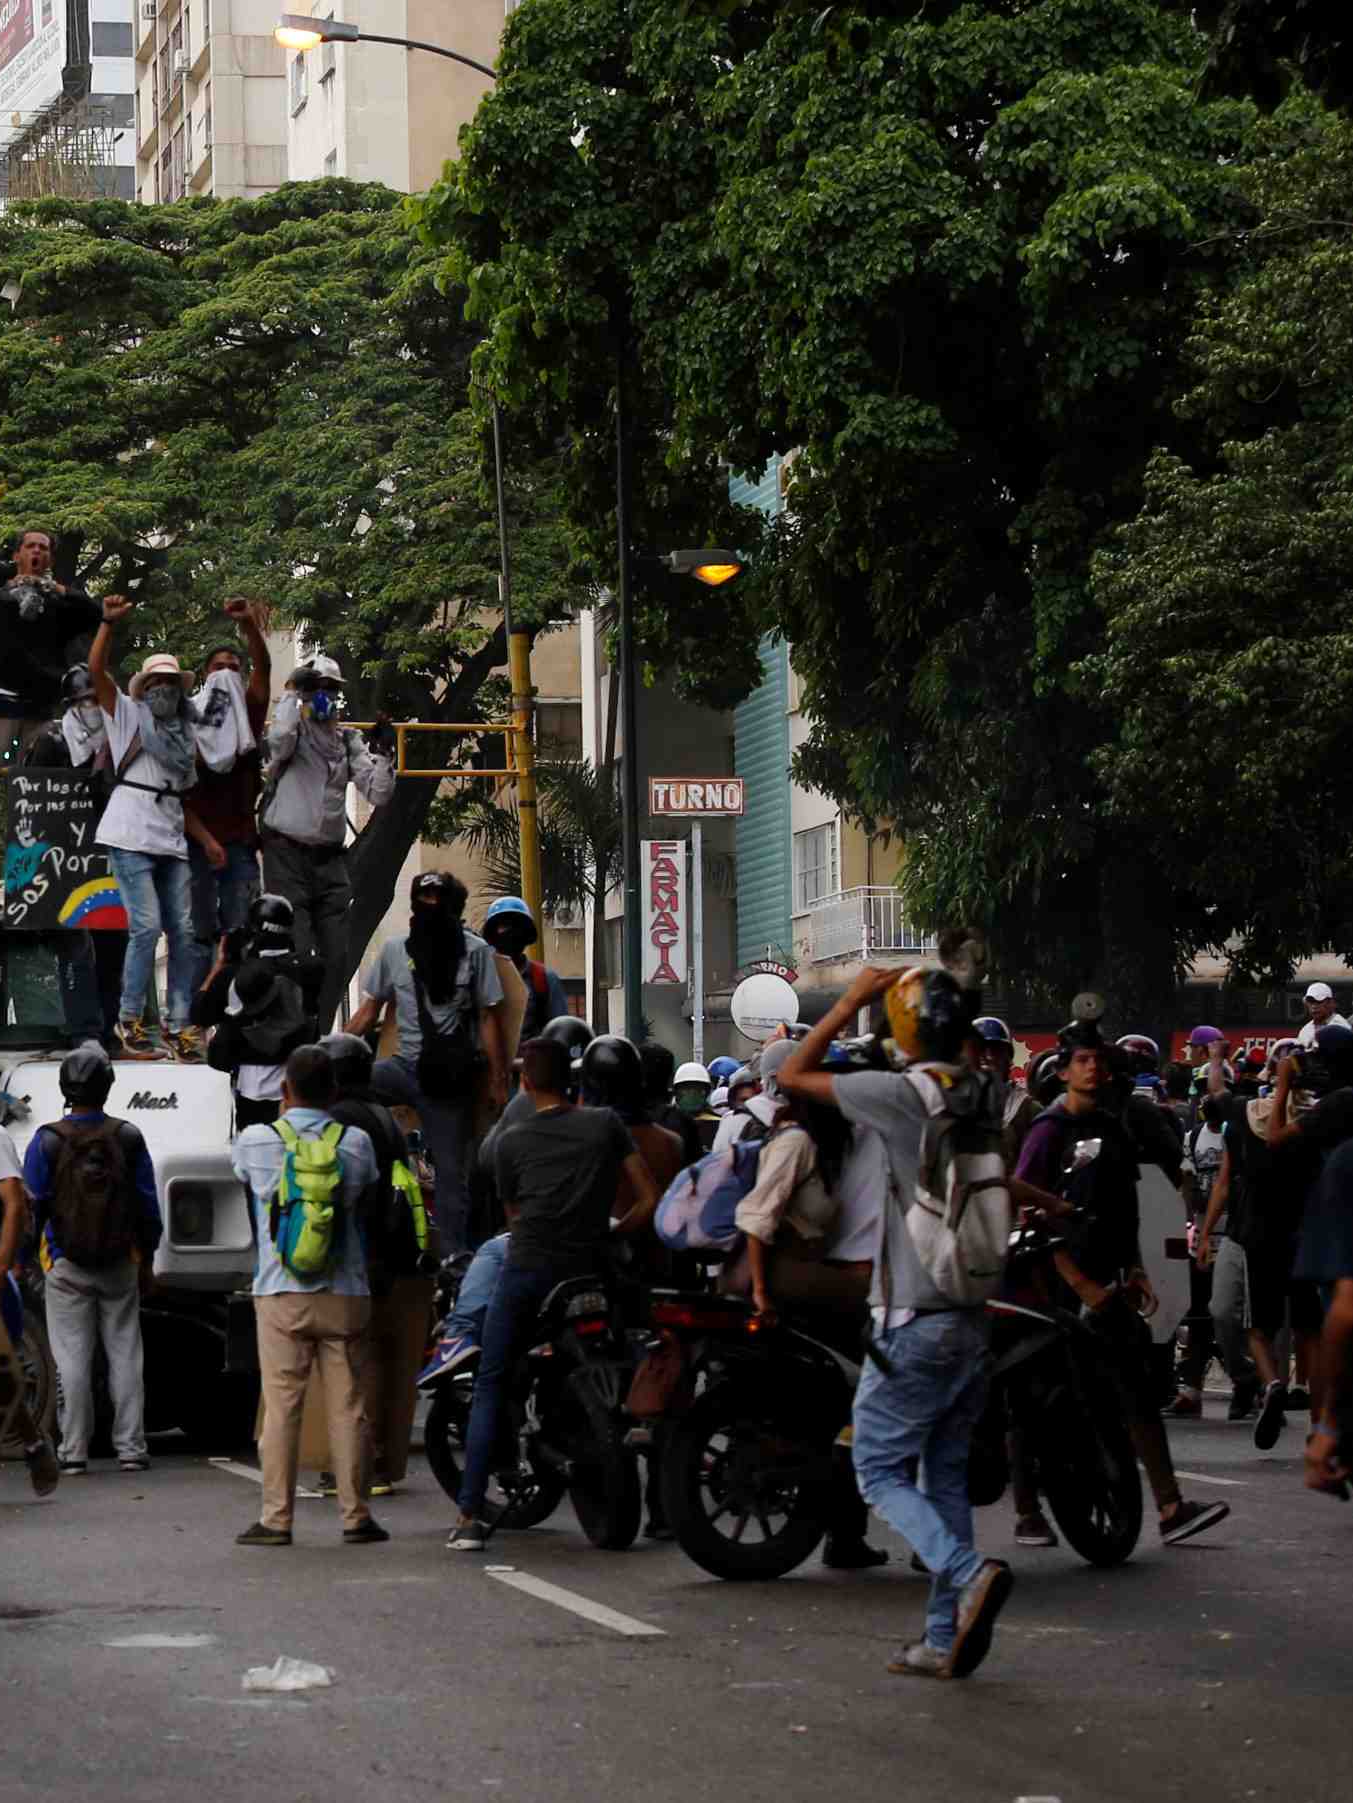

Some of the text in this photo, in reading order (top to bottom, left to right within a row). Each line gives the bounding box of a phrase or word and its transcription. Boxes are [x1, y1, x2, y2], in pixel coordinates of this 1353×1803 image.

[12, 776, 40, 795] Por
[654, 783, 740, 809] TURNO
[15, 798, 42, 815] Por
[42, 846, 96, 880] Por
[650, 842, 680, 983] FARMACIA
[127, 1091, 179, 1109] Mack
